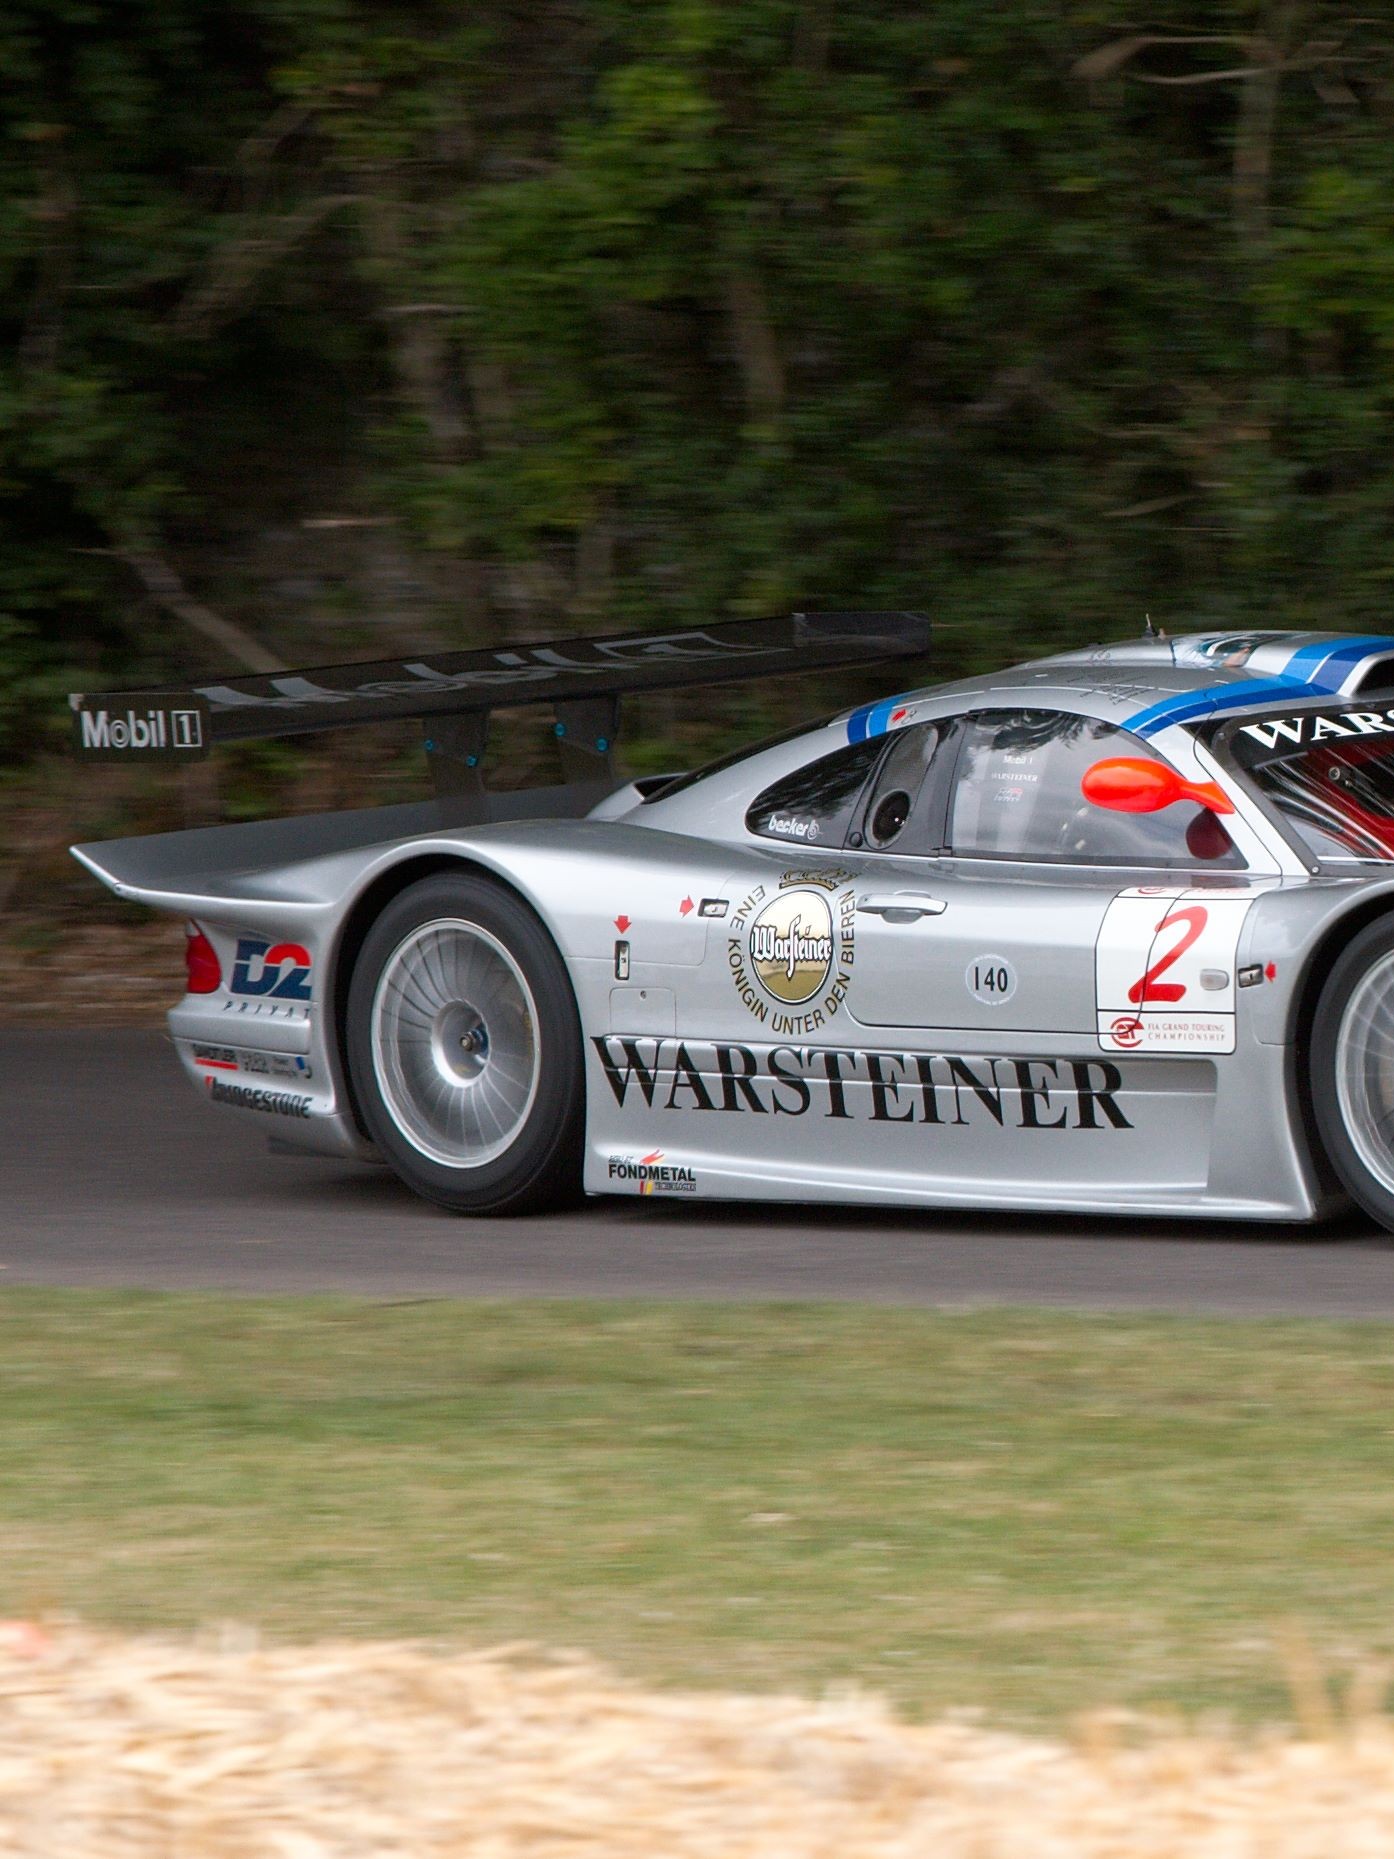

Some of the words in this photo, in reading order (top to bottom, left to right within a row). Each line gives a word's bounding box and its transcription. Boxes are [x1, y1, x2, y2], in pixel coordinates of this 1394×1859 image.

[82, 709, 166, 748] Mobil
[768, 815, 809, 836] becker
[730, 885, 765, 931] EINE
[840, 889, 856, 965] BIEREN
[231, 938, 312, 1000] D2
[1128, 906, 1208, 1003] 2
[728, 939, 769, 1022] KÖNIGIN
[824, 972, 851, 1016] DEN
[974, 966, 1008, 993] 140
[223, 1000, 310, 1019] PRIVAT
[772, 1009, 825, 1035] UNTER
[1147, 1023, 1160, 1031] FIA
[1162, 1023, 1189, 1031] GRAND
[1192, 1023, 1225, 1032] TOURING
[1147, 1033, 1225, 1041] CHAMPIONSHIP
[591, 1036, 1135, 1130] WARSTEINER
[608, 1164, 697, 1182] FONDMETAL
